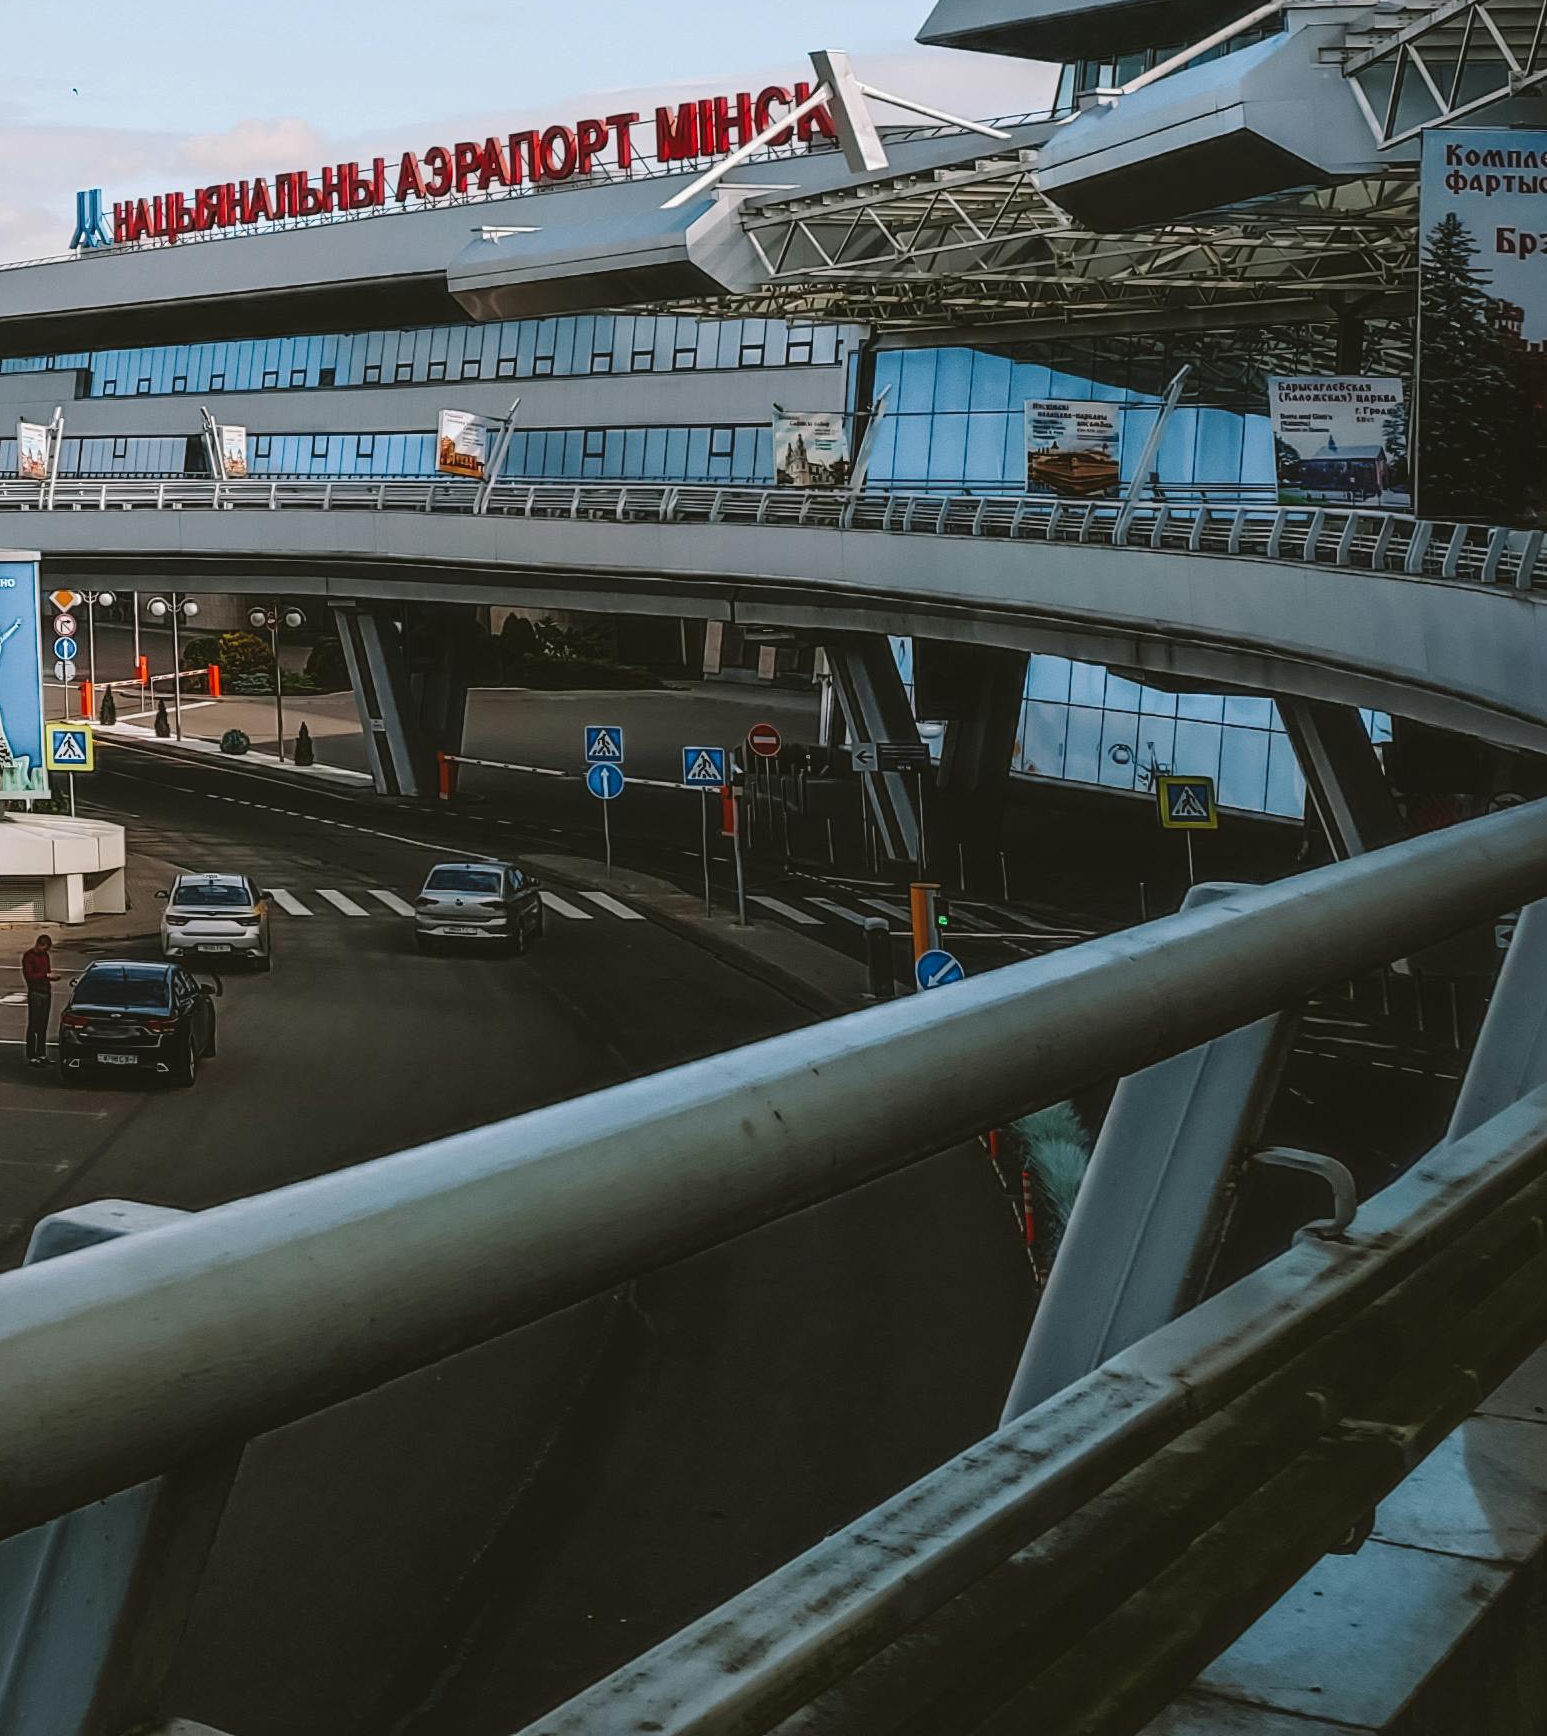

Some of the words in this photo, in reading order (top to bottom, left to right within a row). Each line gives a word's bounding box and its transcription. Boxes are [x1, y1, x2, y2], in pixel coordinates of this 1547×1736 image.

[113, 158, 385, 244] НАЦЫЯНАЛЬНЫ
[395, 112, 639, 202] АЭРАПОРТ
[656, 82, 839, 163] МІНСК
